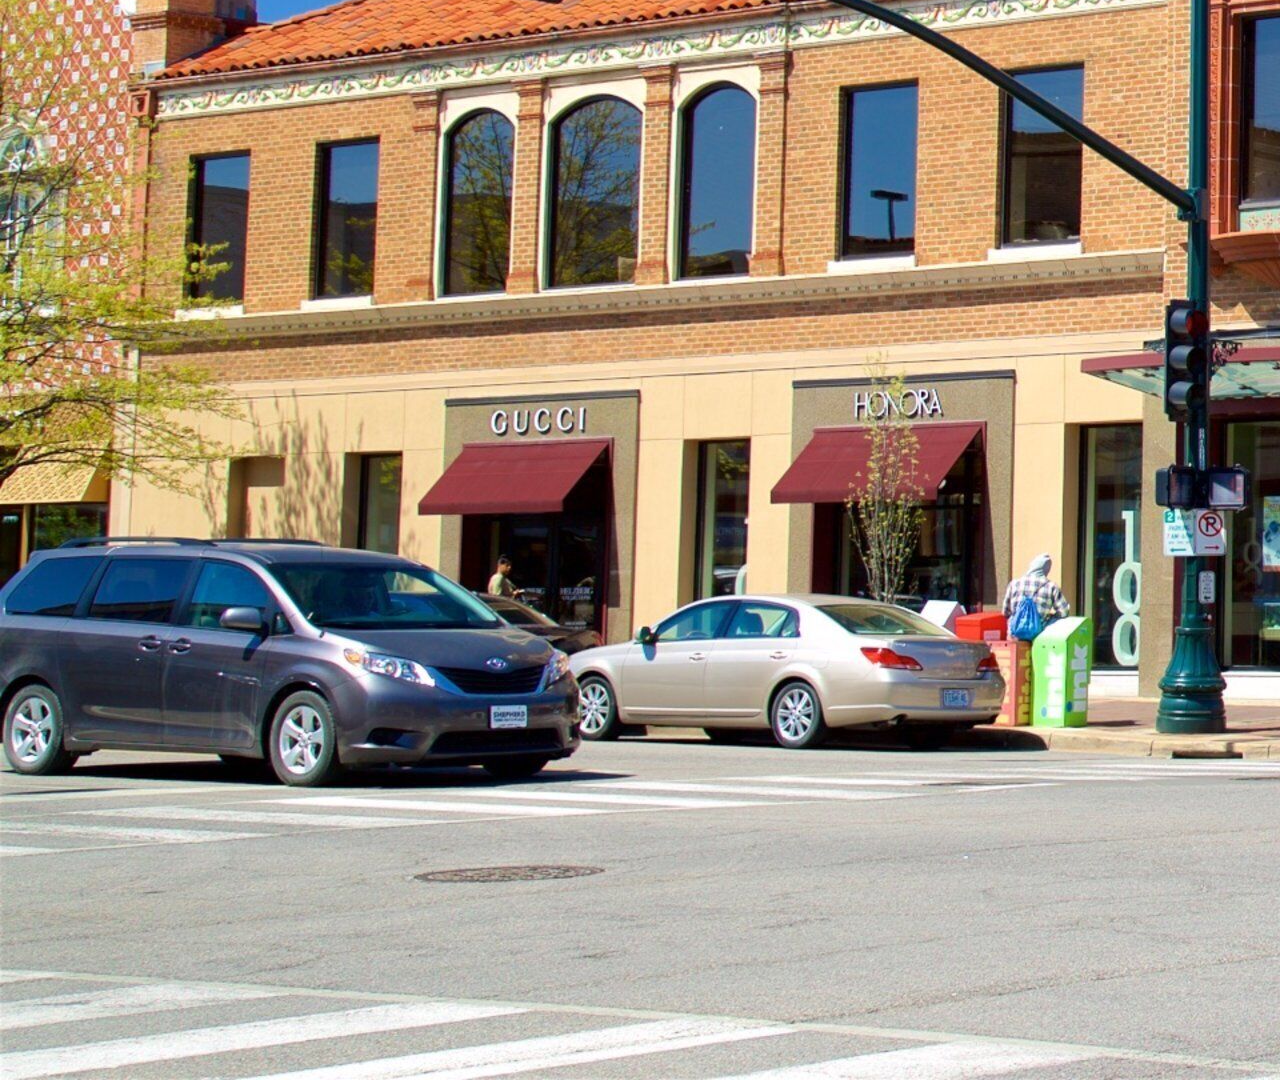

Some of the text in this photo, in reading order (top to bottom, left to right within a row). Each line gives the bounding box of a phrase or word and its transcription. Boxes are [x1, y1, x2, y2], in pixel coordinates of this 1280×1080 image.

[853, 388, 943, 419] HONORA
[490, 406, 587, 435] GUCCI
[1166, 512, 1175, 522] 2
[1041, 651, 1063, 719] ink
[1066, 643, 1089, 713] ink
